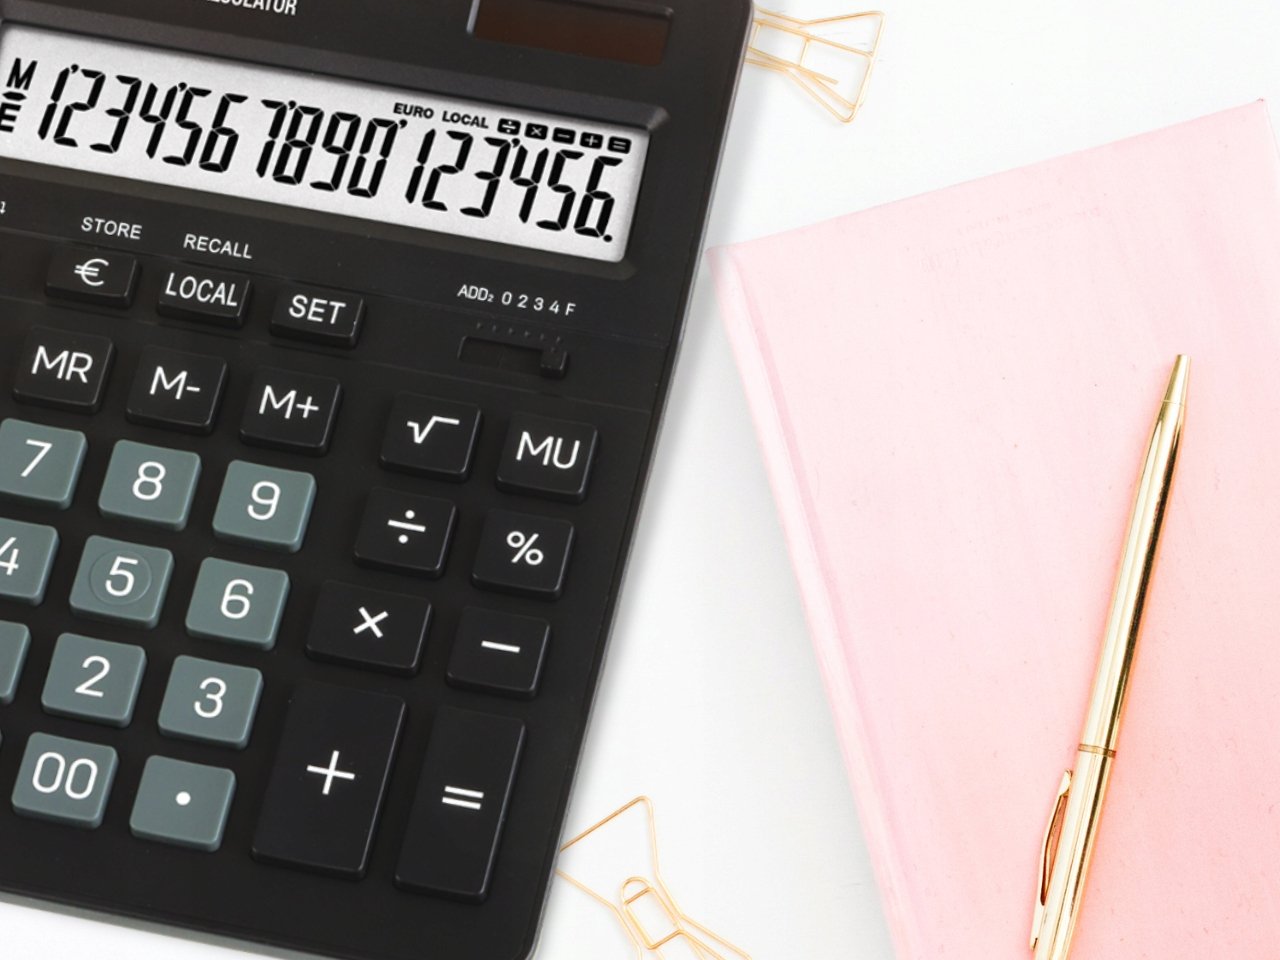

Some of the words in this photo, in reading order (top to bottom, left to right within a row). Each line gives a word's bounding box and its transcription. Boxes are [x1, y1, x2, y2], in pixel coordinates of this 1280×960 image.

[6, 57, 38, 91] M
[393, 102, 435, 119] EURO
[442, 110, 489, 129] LOCAL
[81, 216, 142, 240] STORE
[183, 233, 252, 259] RECALL
[165, 272, 238, 307] LOCAL
[517, 294, 529, 309] 2
[533, 297, 544, 311] 3
[549, 300, 559, 314] 4
[565, 302, 576, 316] F
[289, 294, 346, 324] SET
[31, 345, 93, 383] MR
[149, 366, 200, 400] M-
[259, 385, 319, 419] M+
[21, 439, 52, 477] 7
[516, 431, 580, 469] MU
[132, 461, 166, 500] 8
[247, 481, 281, 521] 9
[506, 531, 544, 566] %
[105, 556, 138, 597] 5
[220, 579, 254, 619] 6
[75, 655, 110, 697] 2
[194, 677, 227, 718] 3
[32, 751, 98, 800] 00
